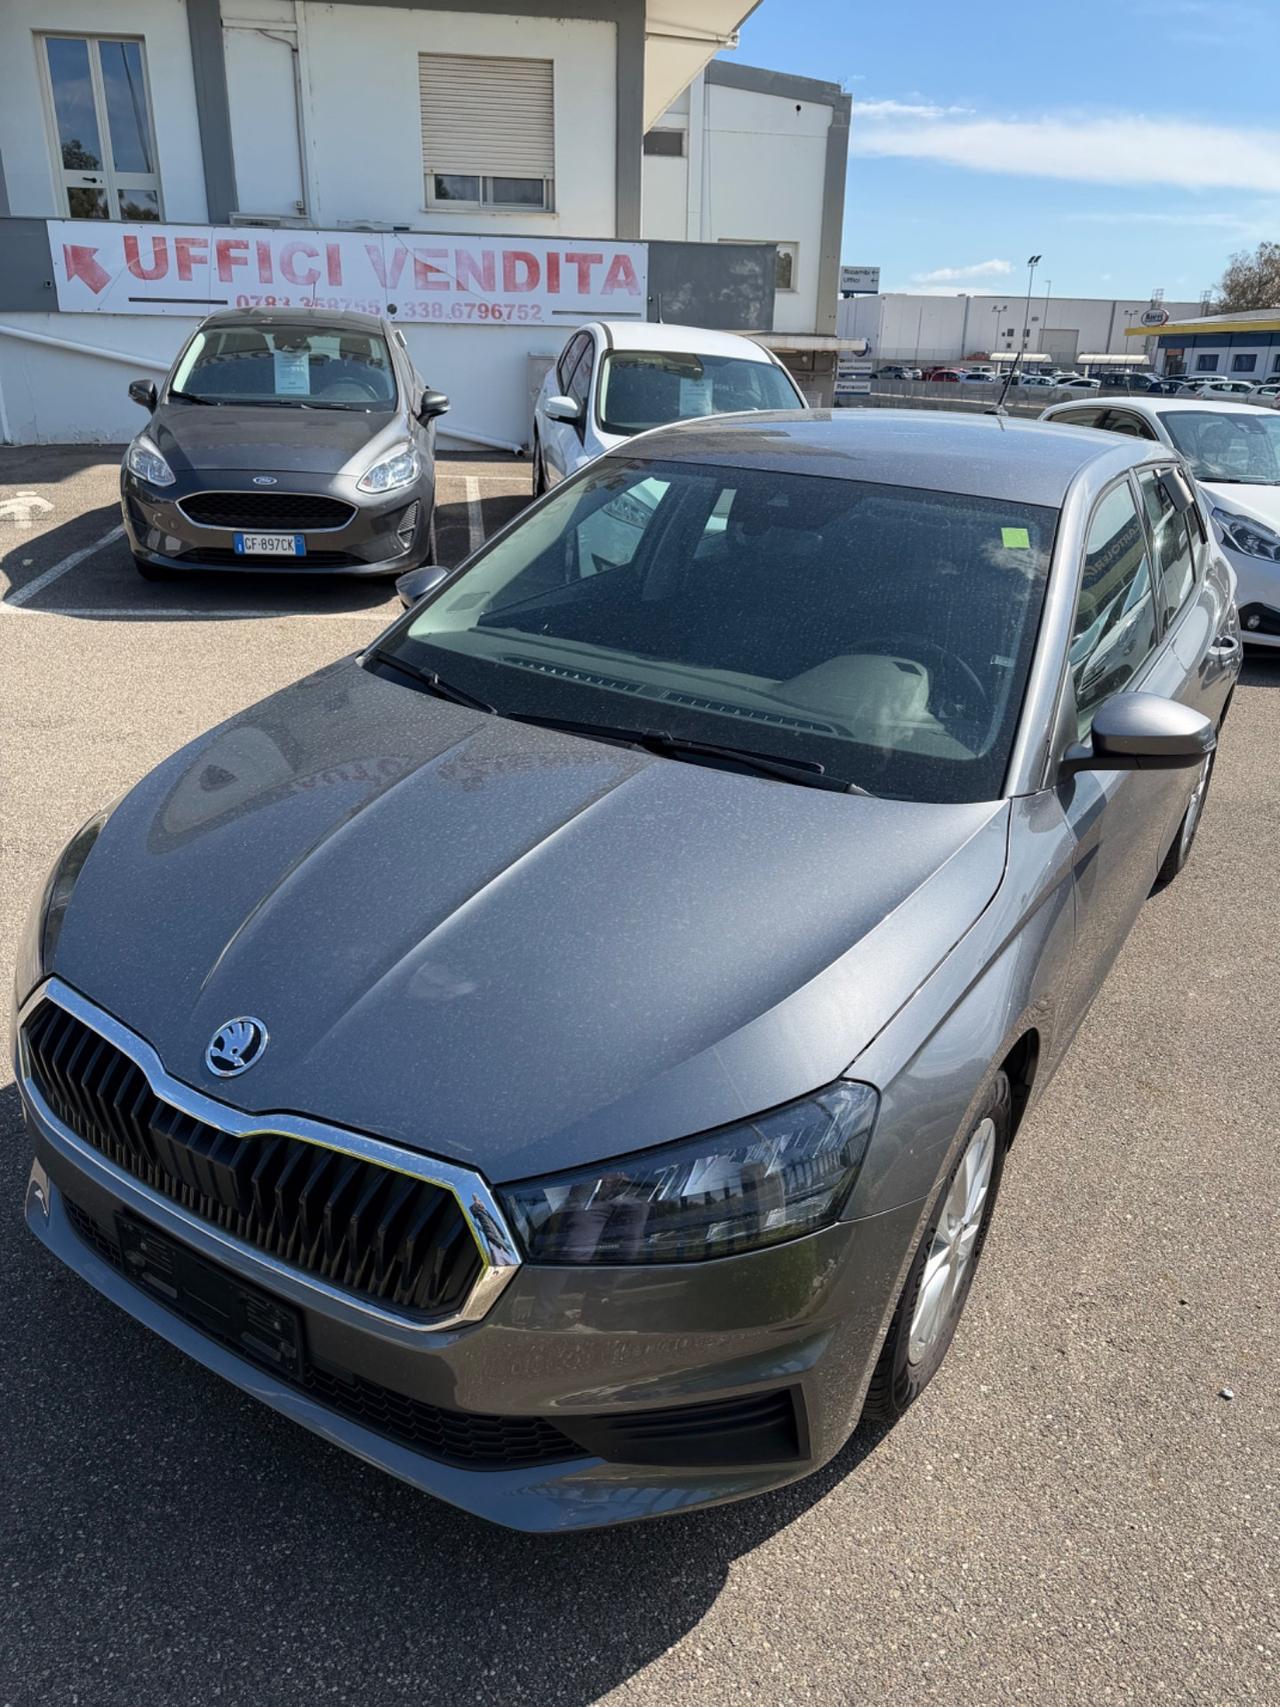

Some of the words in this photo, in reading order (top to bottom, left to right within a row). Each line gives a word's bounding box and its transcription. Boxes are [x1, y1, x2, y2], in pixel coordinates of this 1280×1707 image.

[123, 235, 343, 286] UFFICI
[364, 244, 641, 296] VENDITA
[404, 300, 542, 320] 338.6796752
